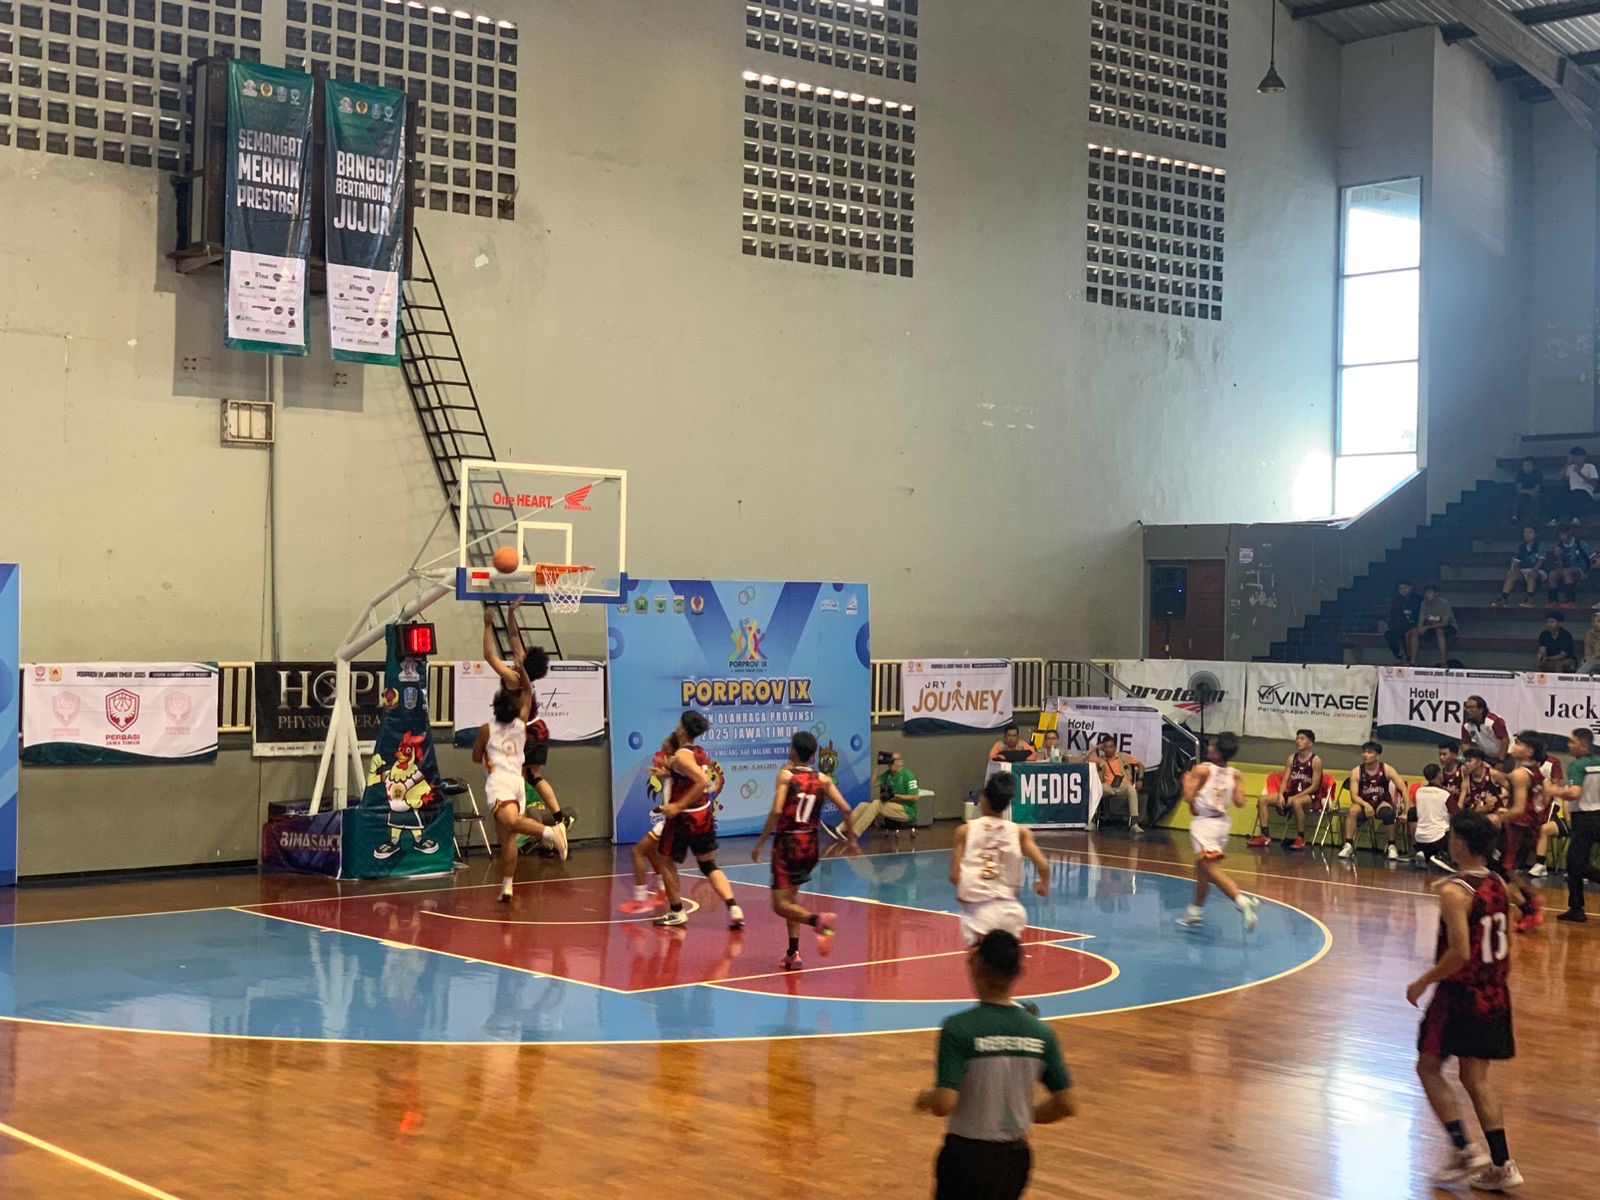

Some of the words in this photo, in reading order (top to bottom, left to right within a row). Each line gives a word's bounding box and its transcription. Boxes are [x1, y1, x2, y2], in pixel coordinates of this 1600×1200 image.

[238, 128, 303, 158] SEMANGAT
[238, 152, 300, 189] MERAIH
[336, 151, 393, 183] BANGGA
[237, 185, 299, 215] PRESTASI
[336, 178, 392, 203] BERTANDING
[334, 199, 390, 236] JUJUR
[492, 491, 514, 507] One
[517, 494, 554, 509] HEART.
[411, 627, 431, 652] 18
[682, 678, 786, 706] PORPROV
[788, 677, 813, 704] IX
[924, 680, 947, 689] JRY
[1409, 687, 1439, 699] Hotel
[1274, 690, 1369, 711] VINTAGE
[718, 712, 767, 724] OLAHRAGA
[770, 711, 814, 722] PROVINSI
[1068, 718, 1095, 731] Hotel
[701, 728, 729, 742] 2025
[734, 727, 761, 740] JAWA
[1020, 772, 1082, 804] MEDIS
[1480, 912, 1508, 964] 13
